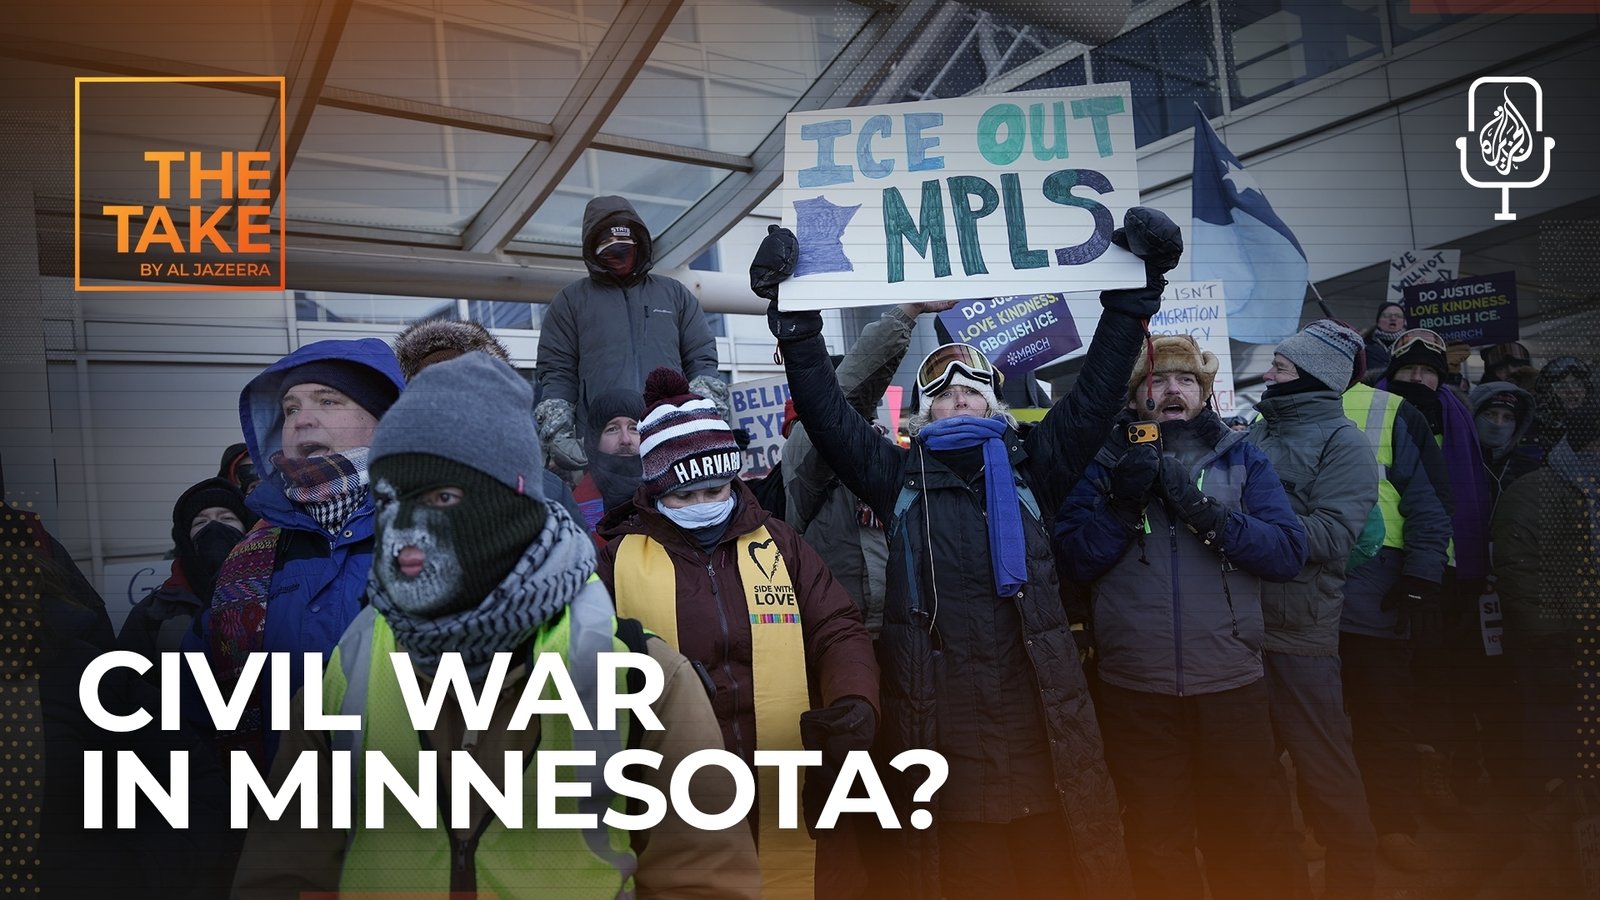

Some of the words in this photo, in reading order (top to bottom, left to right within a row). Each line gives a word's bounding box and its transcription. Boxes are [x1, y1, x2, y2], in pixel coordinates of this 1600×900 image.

[798, 112, 945, 188] ICE
[977, 96, 1126, 166] OUT
[882, 169, 1115, 283] MPLS
[1392, 251, 1416, 271] WE
[1175, 284, 1217, 301] ISN'T
[1419, 290, 1438, 302] DO
[1440, 282, 1496, 299] JUSTICE.
[961, 301, 985, 320] DO
[1410, 303, 1439, 317] LOVE
[1442, 294, 1511, 313] KINDNESS.
[958, 316, 997, 343] LOVE
[996, 293, 1059, 325] KINDNESS.
[1419, 313, 1471, 329] ABOLISH
[1475, 310, 1501, 322] ICE.
[980, 321, 1035, 354] ABOLISH
[1033, 310, 1059, 330] ICE.
[1016, 337, 1051, 359] MARCH
[754, 585, 773, 593] SIDE
[755, 593, 795, 606] LOVE
